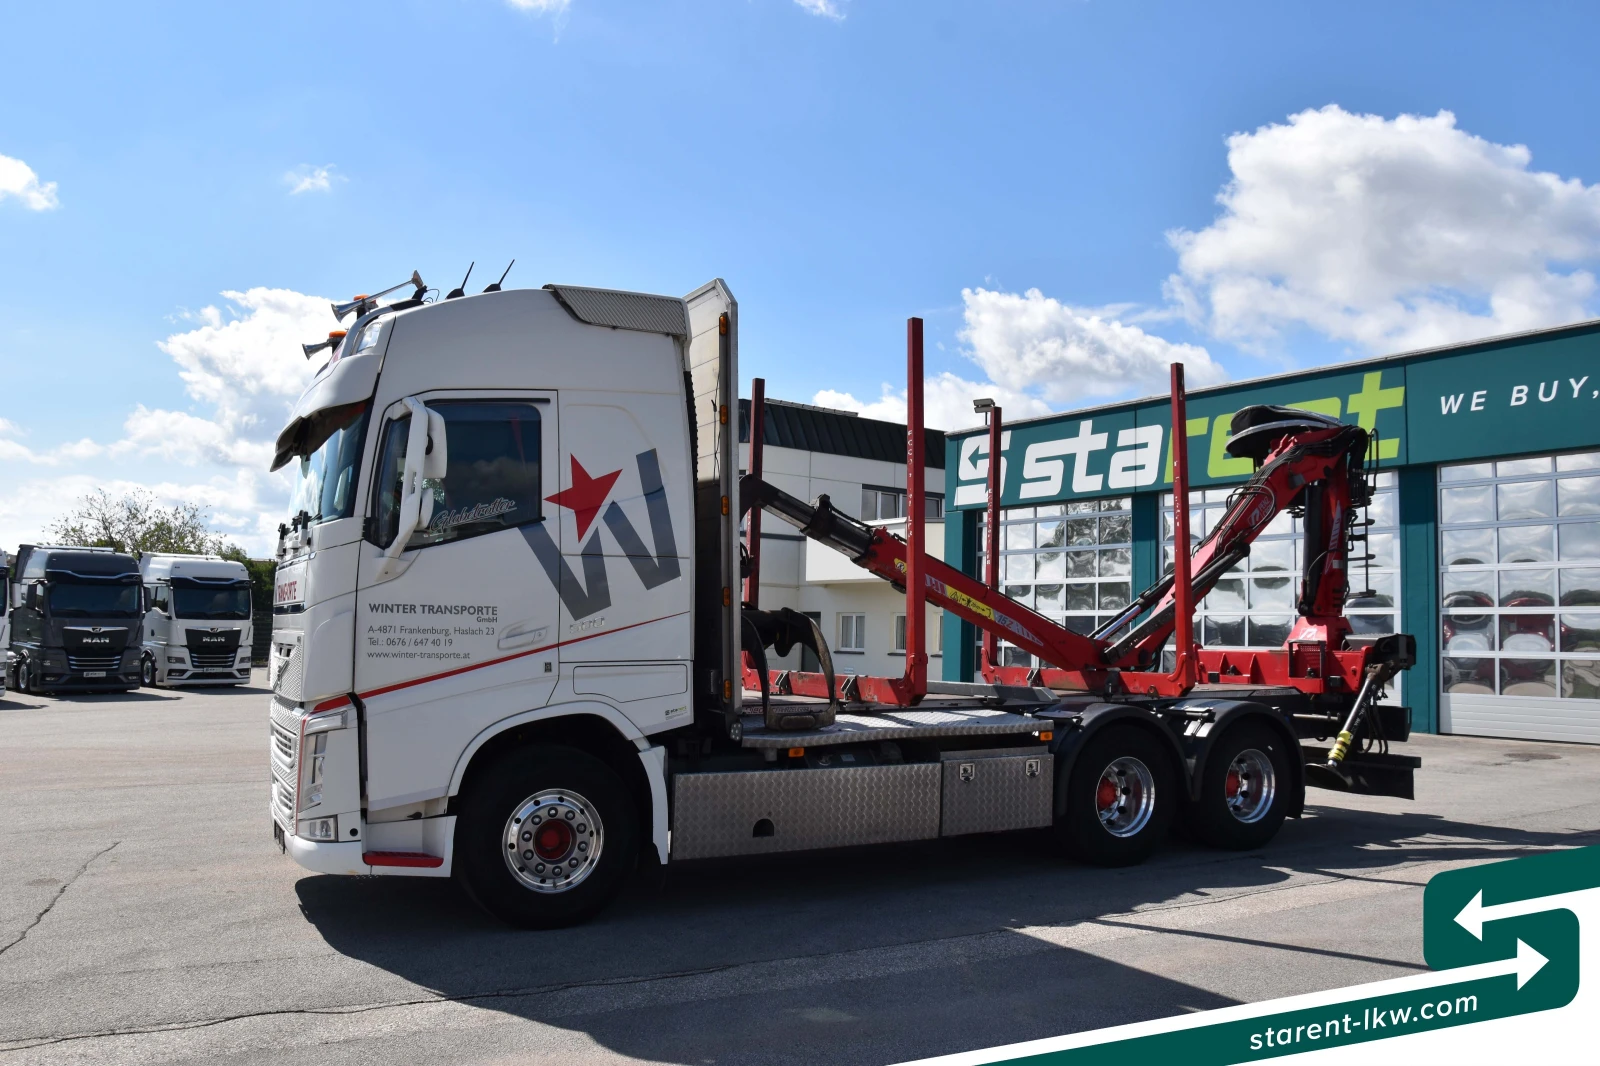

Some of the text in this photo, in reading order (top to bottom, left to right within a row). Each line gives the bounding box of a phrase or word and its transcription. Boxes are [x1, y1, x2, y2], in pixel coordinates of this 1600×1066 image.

[1440, 376, 1599, 415] WE BUY,
[430, 497, 516, 532] Globetrotter
[368, 603, 498, 616] WINTER TRANSPORTE
[367, 625, 495, 637] A-4871 Frankenburg, Haslach 23
[367, 637, 384, 646] Tel.:
[386, 637, 407, 646] 0676
[413, 638, 429, 647] 647
[430, 638, 441, 647] 40
[444, 638, 453, 647] 19
[367, 651, 471, 660] www.winter-transporte.at
